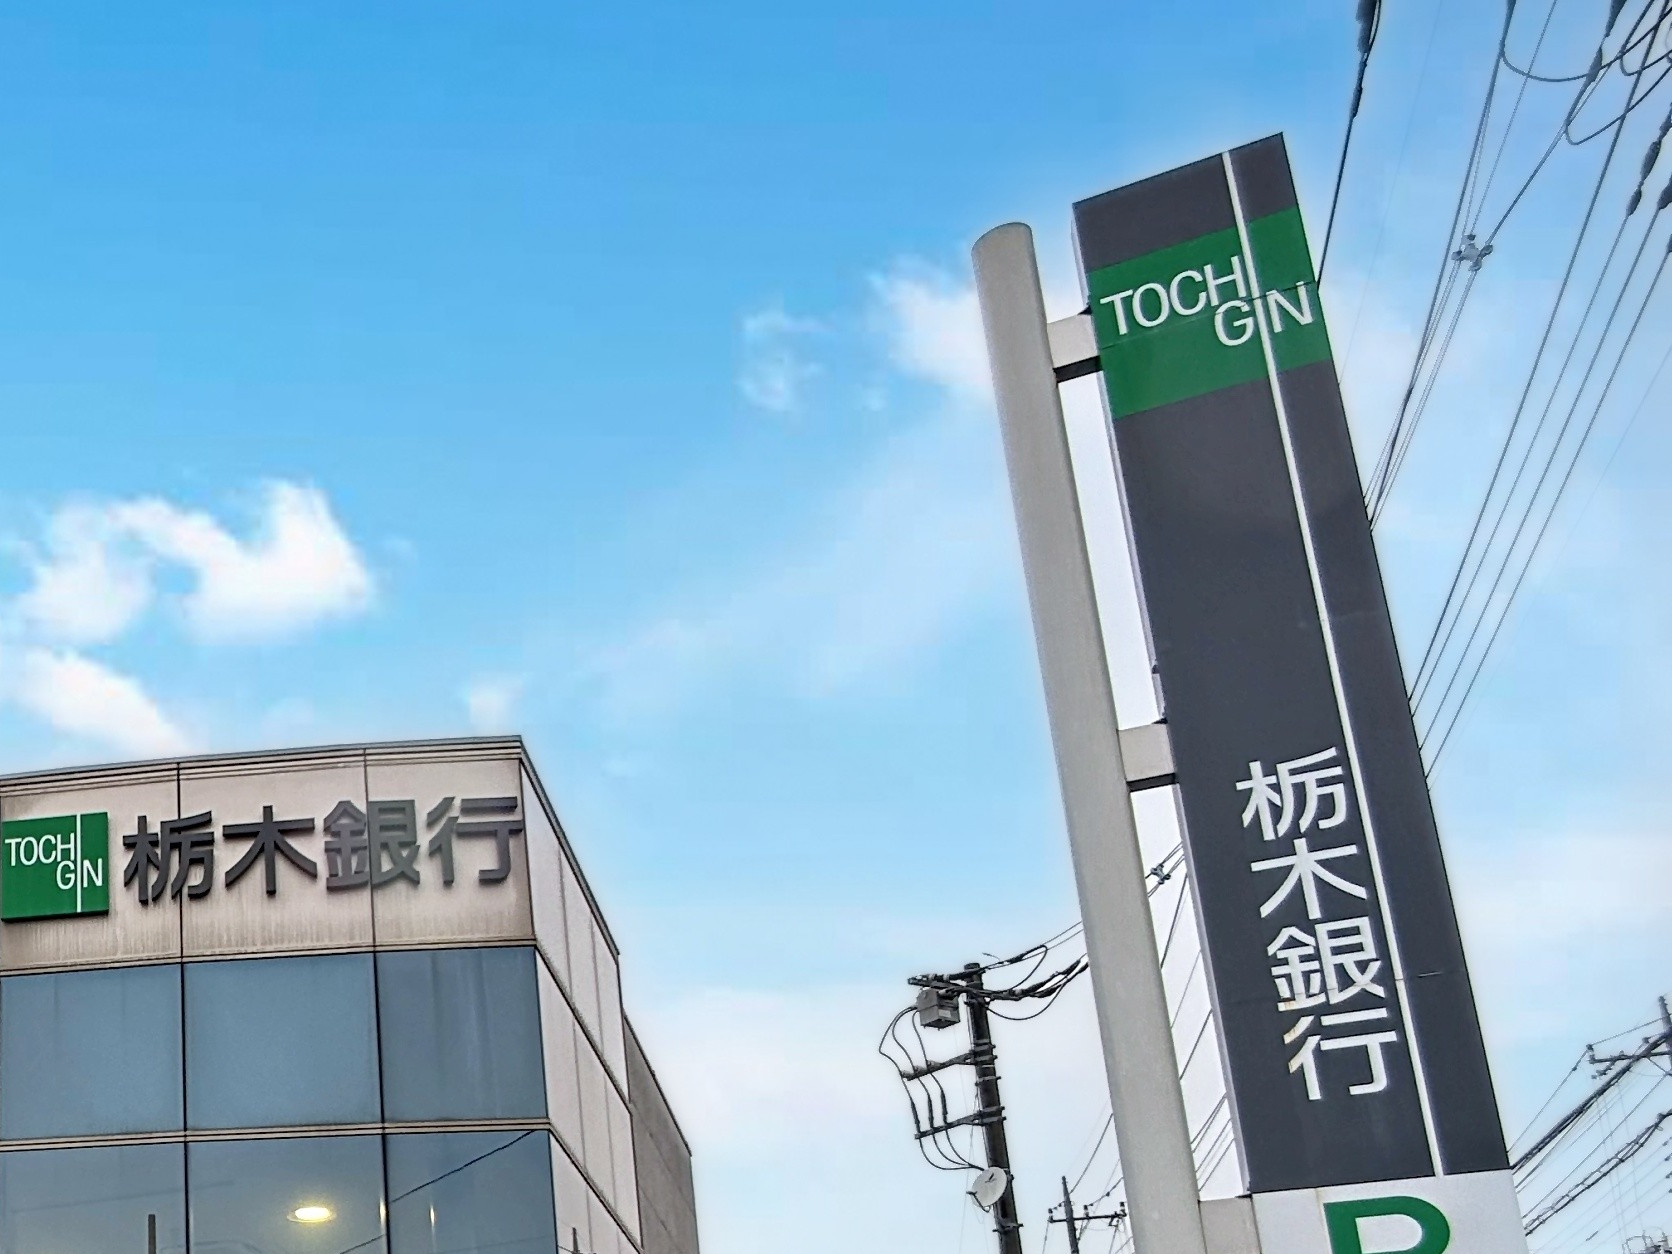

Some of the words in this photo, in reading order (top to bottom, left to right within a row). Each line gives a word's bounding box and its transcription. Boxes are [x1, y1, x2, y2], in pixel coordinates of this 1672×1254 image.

[1100, 255, 1247, 335] TOCH
[4, 834, 76, 867] TOCH
[122, 796, 524, 905] 栃木銀行
[1236, 746, 1397, 1101] 栃木銀行
